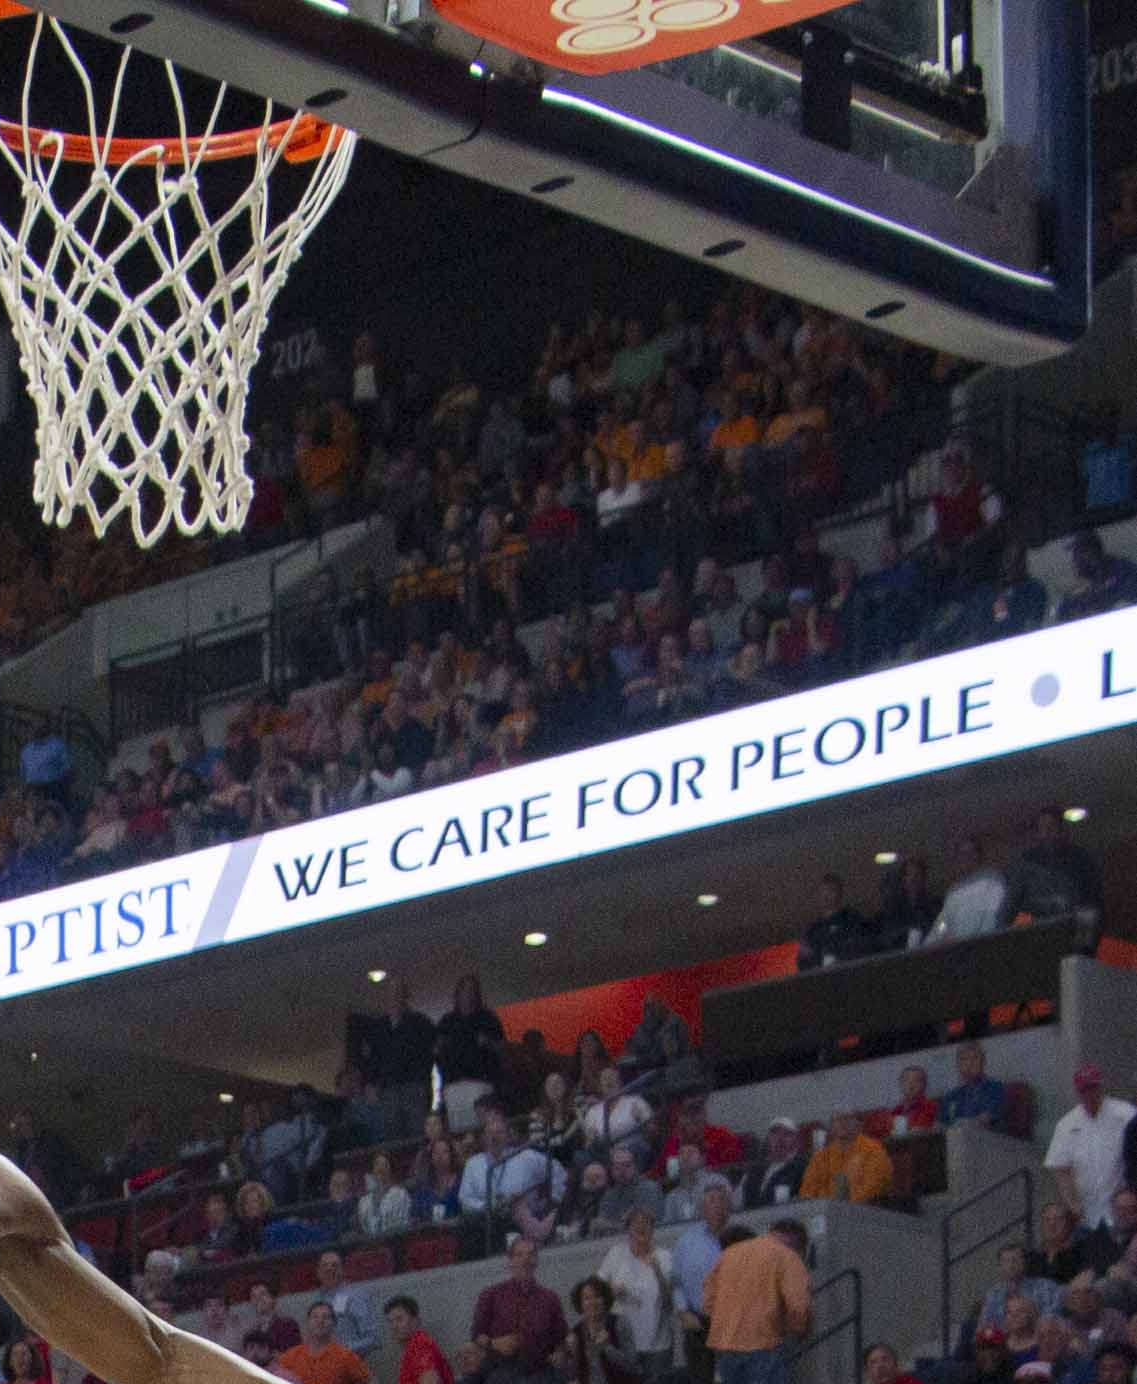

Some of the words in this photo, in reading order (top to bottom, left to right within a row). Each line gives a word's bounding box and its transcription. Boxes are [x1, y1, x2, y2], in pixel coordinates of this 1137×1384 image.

[272, 839, 369, 902] WE
[389, 792, 551, 873] CARE
[576, 754, 707, 831] FOR
[730, 679, 995, 791] PEOPLE
